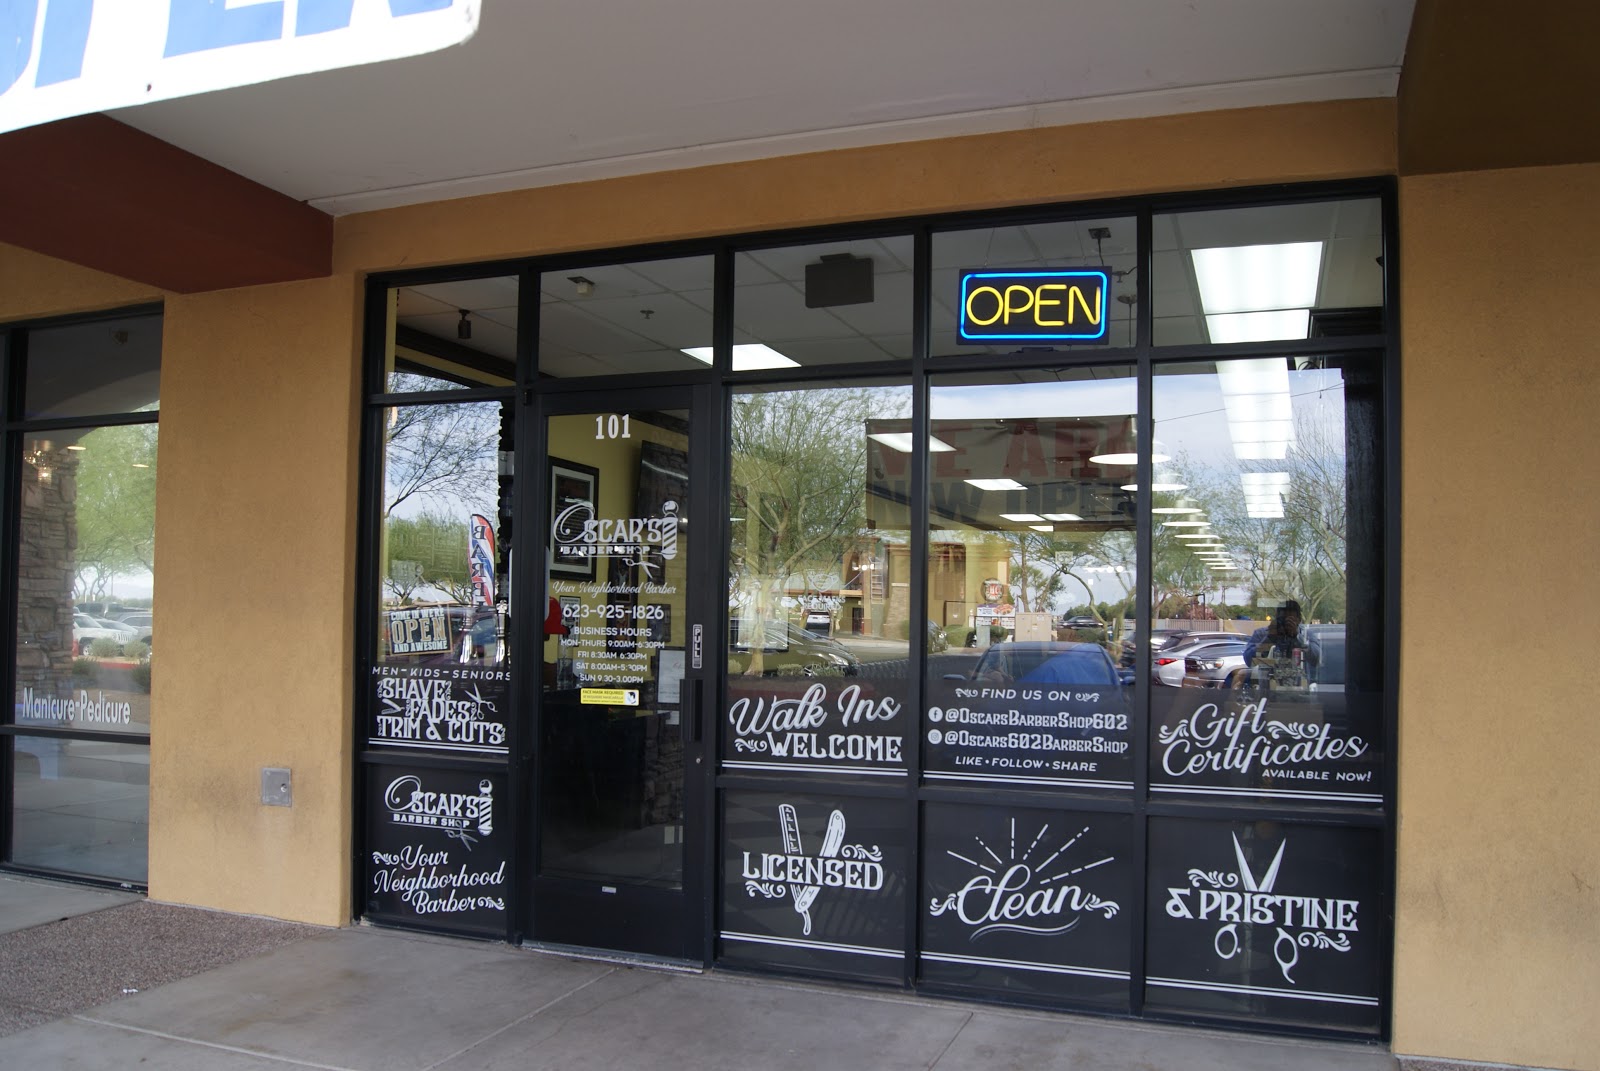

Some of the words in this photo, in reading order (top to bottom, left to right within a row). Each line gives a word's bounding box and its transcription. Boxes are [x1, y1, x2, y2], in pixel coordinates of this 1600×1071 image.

[966, 284, 1101, 326] OPEN
[595, 414, 631, 439] 101
[553, 503, 662, 543] OSCAR'S
[561, 545, 613, 555] BARBER
[621, 546, 651, 555] SHOP
[553, 581, 575, 593] Your
[579, 581, 643, 598] Neighborhood
[644, 581, 676, 595] Barber
[562, 604, 664, 620] 623-925-1826
[391, 617, 447, 644] OPEN
[560, 639, 607, 647] MON-THURS
[574, 627, 618, 636] BUSINESS
[619, 627, 652, 637] HOURS
[394, 643, 410, 653] AND
[410, 640, 448, 652] AWESOME
[381, 677, 447, 700] SHAVE
[579, 674, 596, 682] SUN
[981, 688, 1017, 699] FIND
[1022, 690, 1042, 701] US
[1048, 691, 1071, 702] ON
[410, 699, 472, 722] FADES
[729, 683, 828, 737] Walk
[837, 684, 902, 727] Ins
[1190, 697, 1268, 748] Gift
[377, 715, 422, 740] TRIM
[425, 719, 442, 741] &
[447, 720, 503, 745] CUTS
[766, 732, 903, 762] WELCOME
[1162, 723, 1369, 777] Certificates
[955, 756, 983, 766] LIKE
[991, 757, 1044, 769] FOLLOW
[1052, 761, 1098, 772] SHARE
[1262, 769, 1330, 780] AVAILABLE
[1336, 771, 1372, 782] NOW!
[384, 775, 479, 818] OSCAR'S
[393, 813, 437, 825] BARBER
[441, 818, 470, 828] SHOP
[400, 844, 449, 870] Your
[373, 861, 506, 902] Neighborhood
[742, 851, 884, 891] LICENSED
[412, 889, 476, 914] Barber
[956, 864, 1090, 925] Clean
[1198, 889, 1360, 932] PRISTINE
